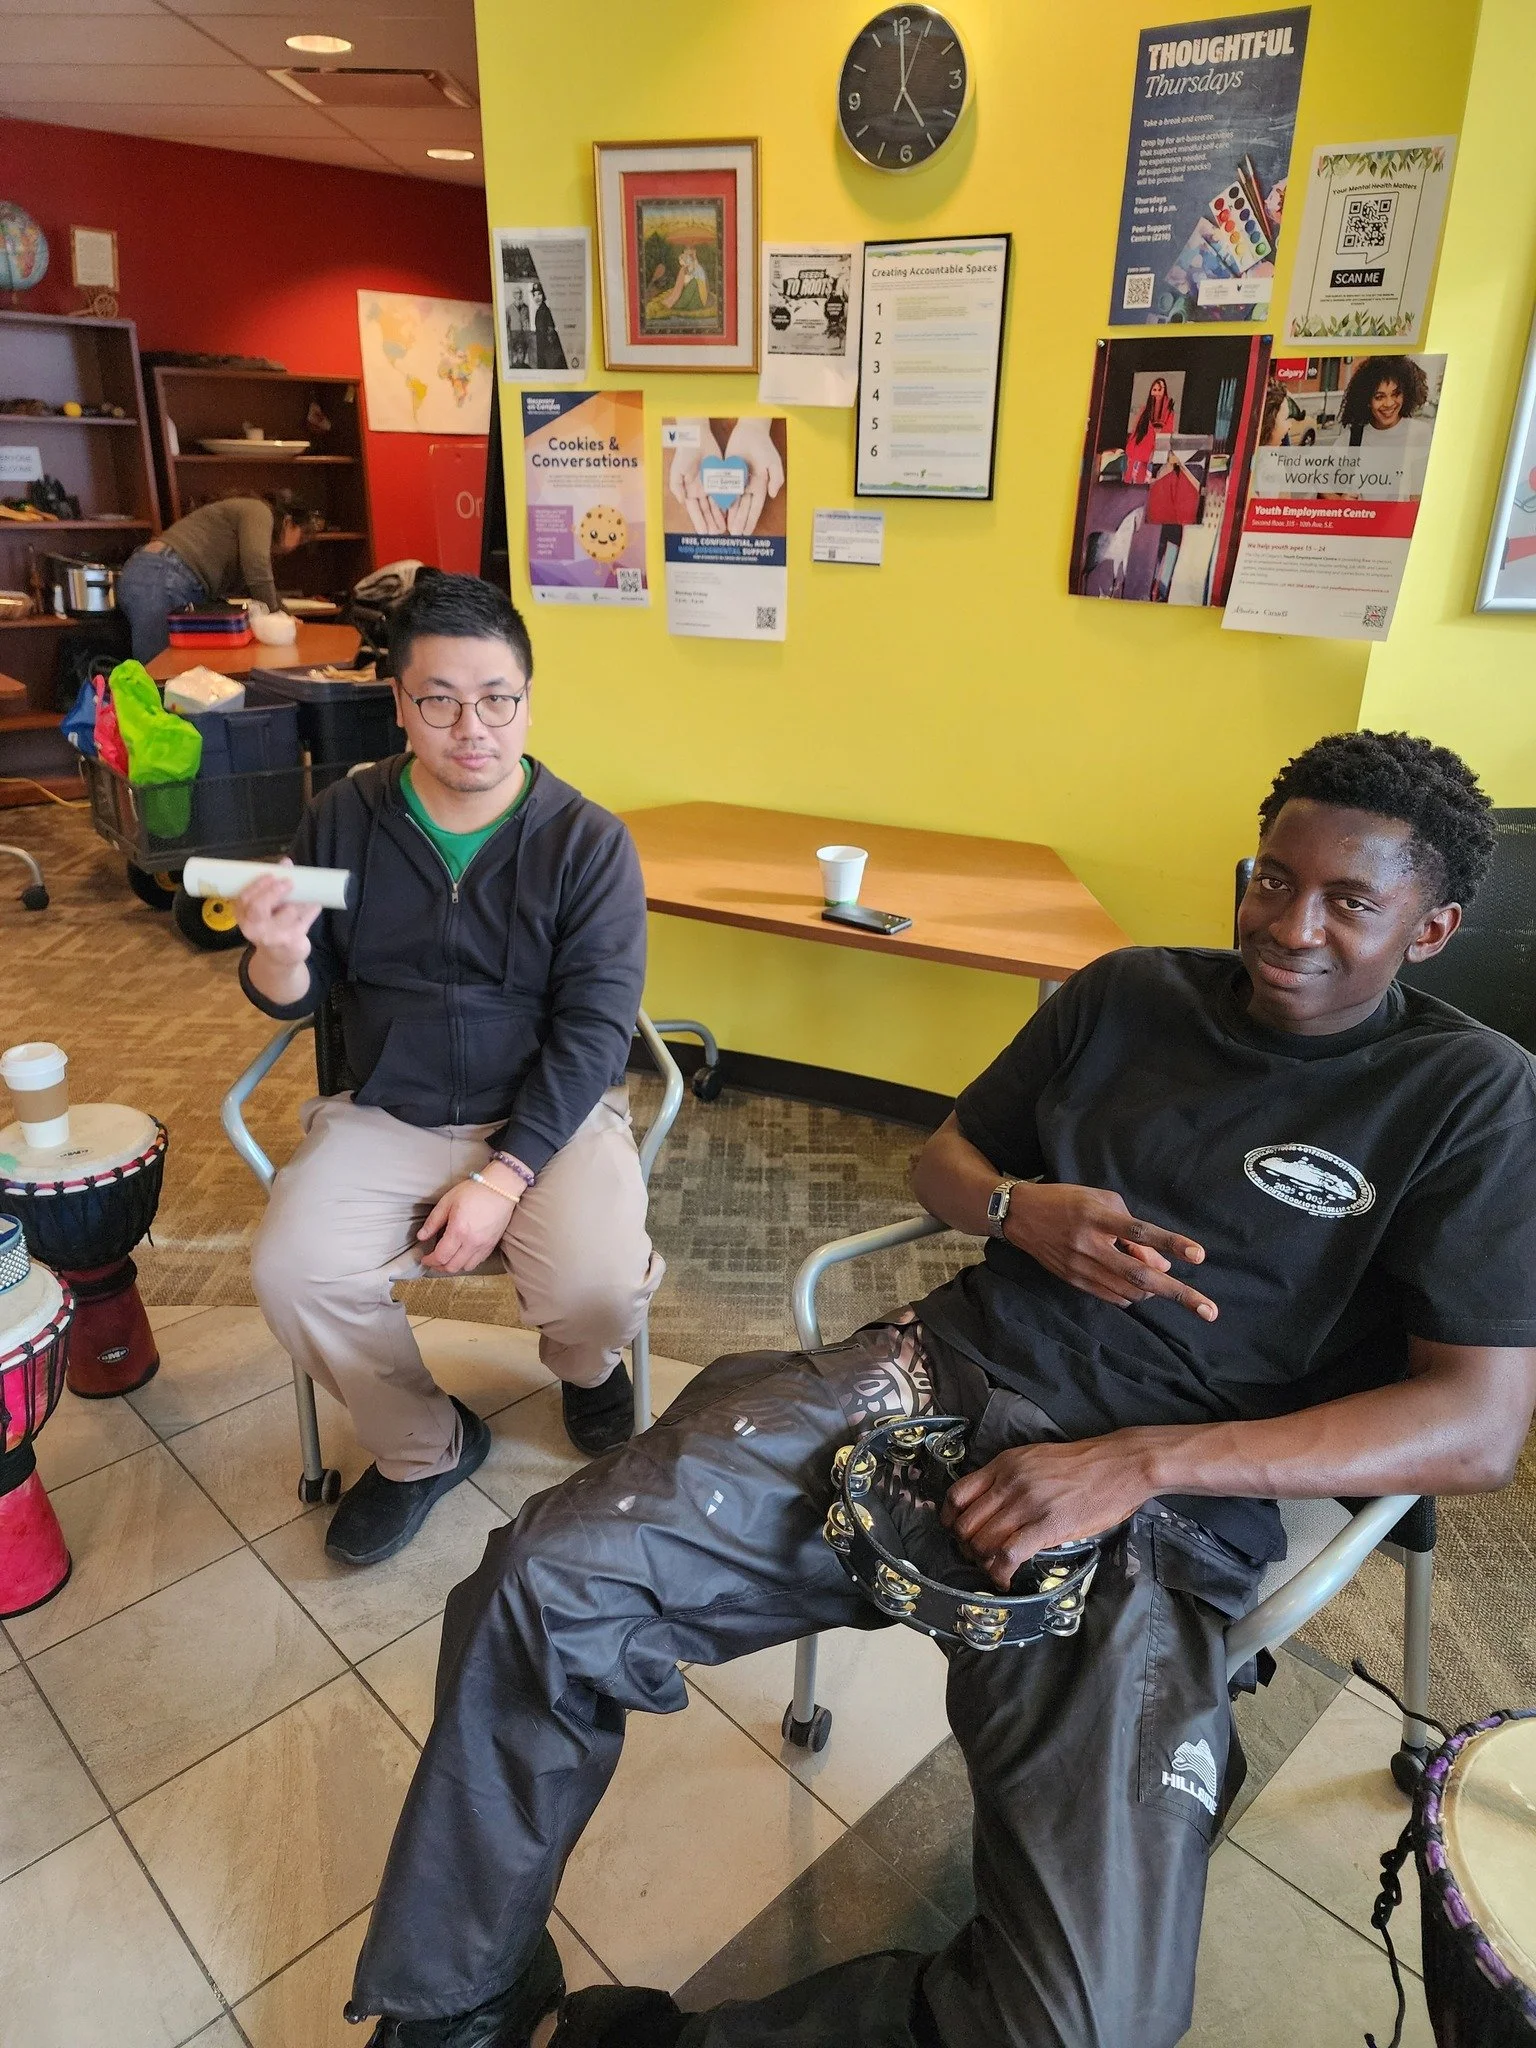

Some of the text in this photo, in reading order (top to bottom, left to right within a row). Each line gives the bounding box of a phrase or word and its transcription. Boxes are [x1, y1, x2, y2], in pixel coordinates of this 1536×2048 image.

[893, 16, 911, 37] 12
[1148, 26, 1294, 71] THOUGHTFUL
[949, 69, 963, 90] 3
[1145, 69, 1244, 99] Thursdays
[848, 92, 861, 111] 9
[900, 144, 913, 163] 6
[1332, 182, 1417, 195] Your Mental Health Matters
[1134, 196, 1167, 206] Thursdays
[1131, 224, 1172, 234] Peer Support
[1130, 235, 1152, 243] Centre
[871, 264, 998, 278] Creating Accountable Spaces
[1334, 272, 1380, 285] SCAN ME
[786, 278, 800, 296] TO
[877, 303, 882, 316] 1
[875, 332, 882, 345] 2
[873, 361, 880, 374] 3
[1278, 368, 1304, 379] Calgary
[872, 389, 880, 402] 4
[871, 418, 879, 430] 5
[548, 436, 620, 451] Cookies &
[870, 445, 878, 457] 6
[531, 454, 639, 468] Conversations
[1304, 455, 1335, 467] work
[1338, 455, 1361, 467] that
[1285, 468, 1329, 484] works
[1333, 468, 1356, 485] for
[1255, 505, 1376, 519] Youth Employment Centre
[1252, 519, 1271, 527] Second
[742, 547, 775, 557] SUPPORT
[1272, 544, 1289, 552] youth
[1273, 1182, 1296, 1195] 2025
[1161, 1770, 1218, 1816] HILLSIDE
